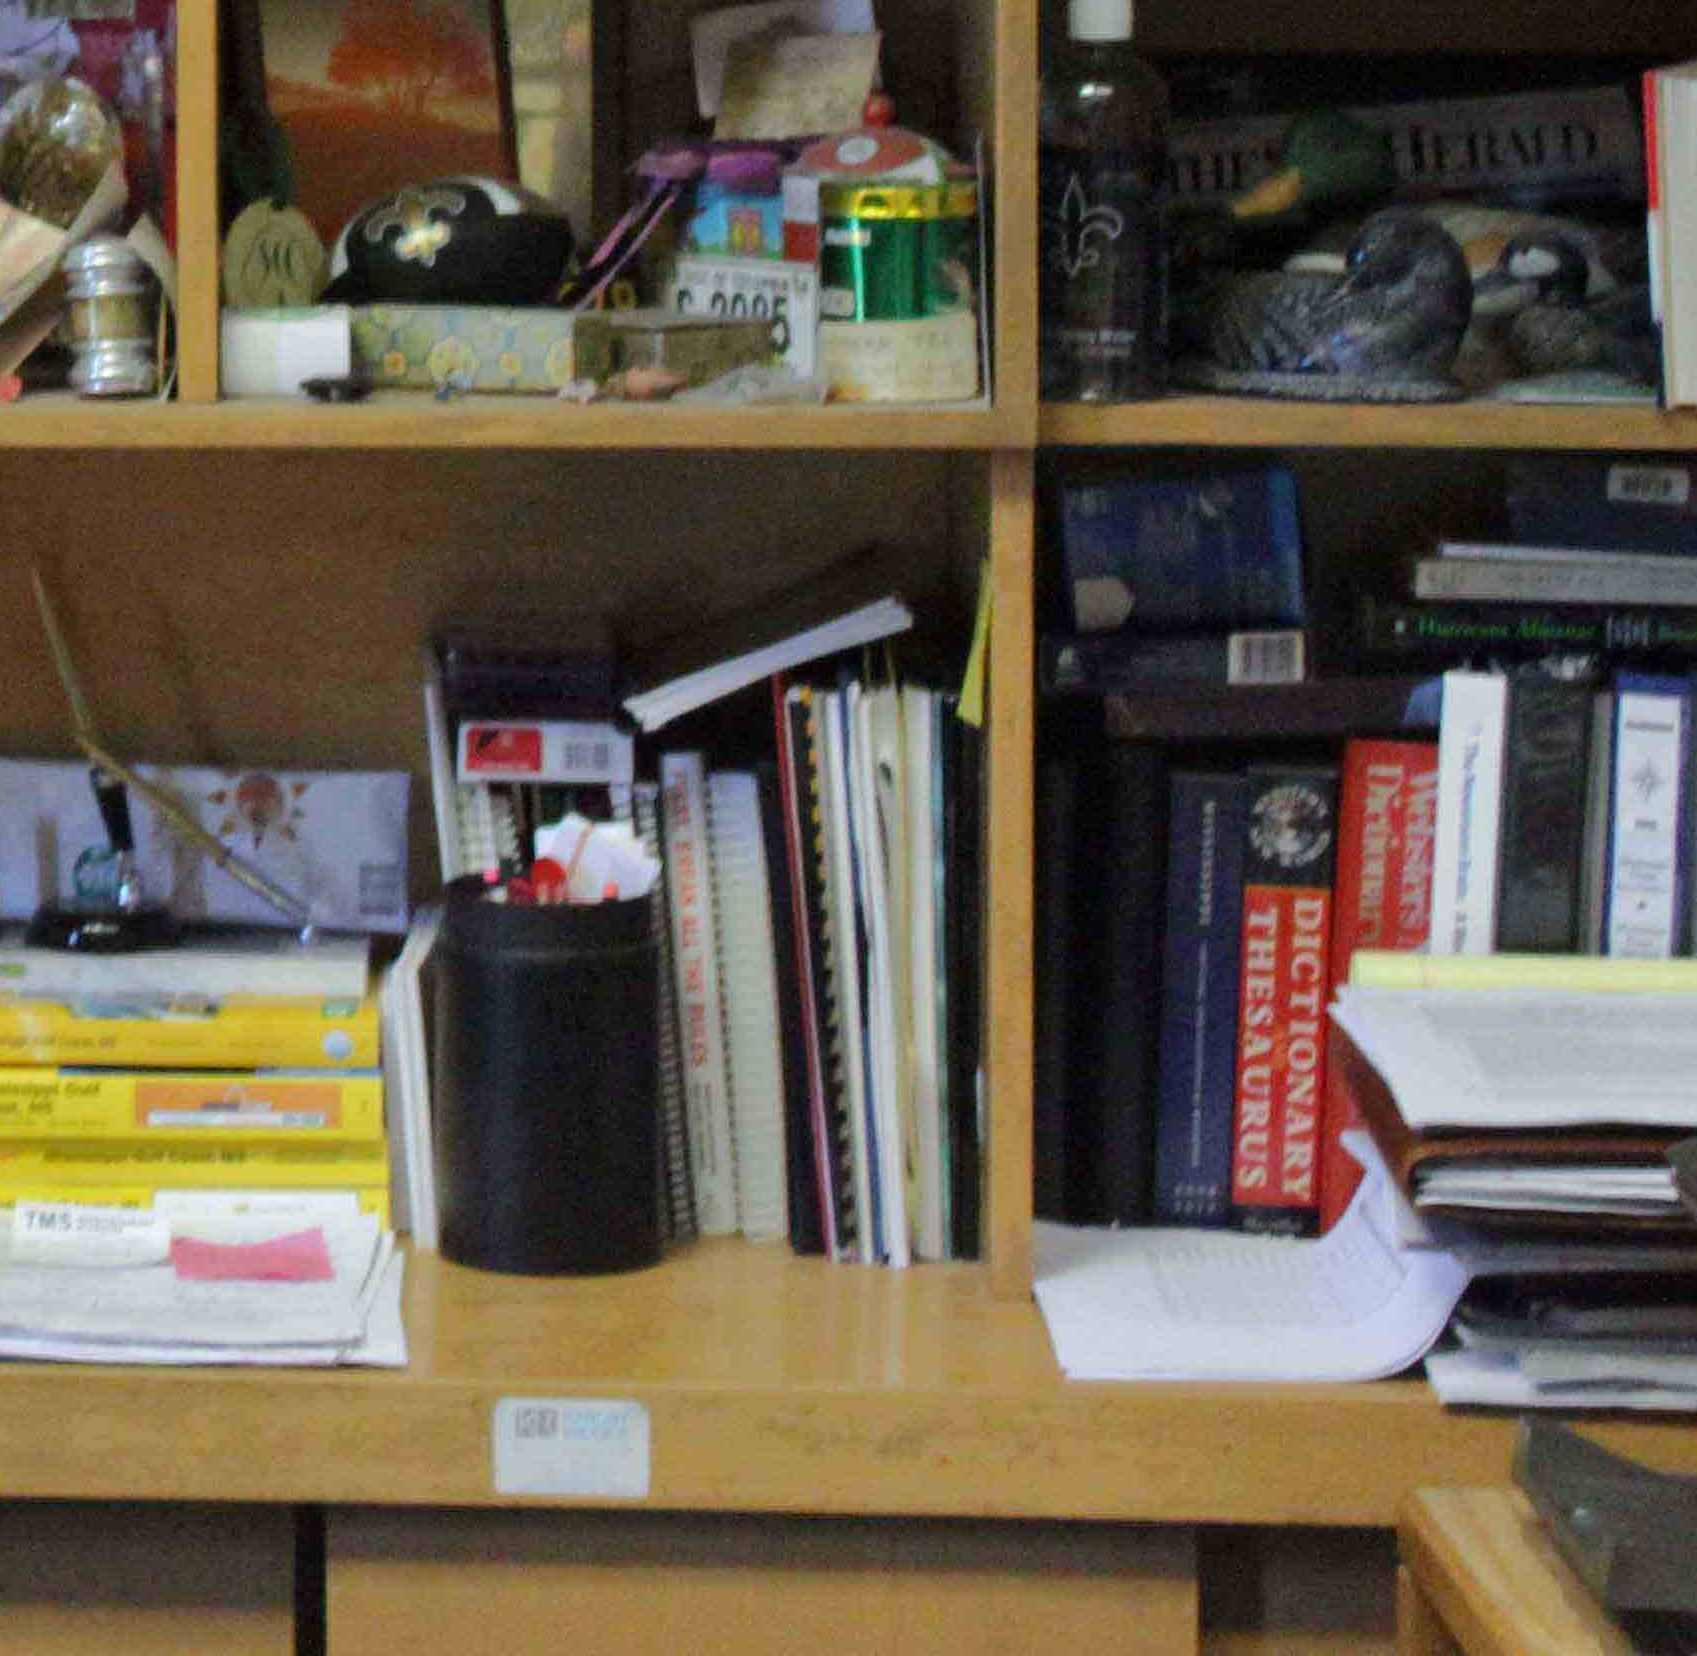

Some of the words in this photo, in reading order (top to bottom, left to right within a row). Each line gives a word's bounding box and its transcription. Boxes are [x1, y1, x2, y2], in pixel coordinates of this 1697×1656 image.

[1236, 907, 1280, 1191] THESAURUS
[1281, 896, 1325, 1202] DICTIONARY
[26, 1210, 72, 1231] TMS
